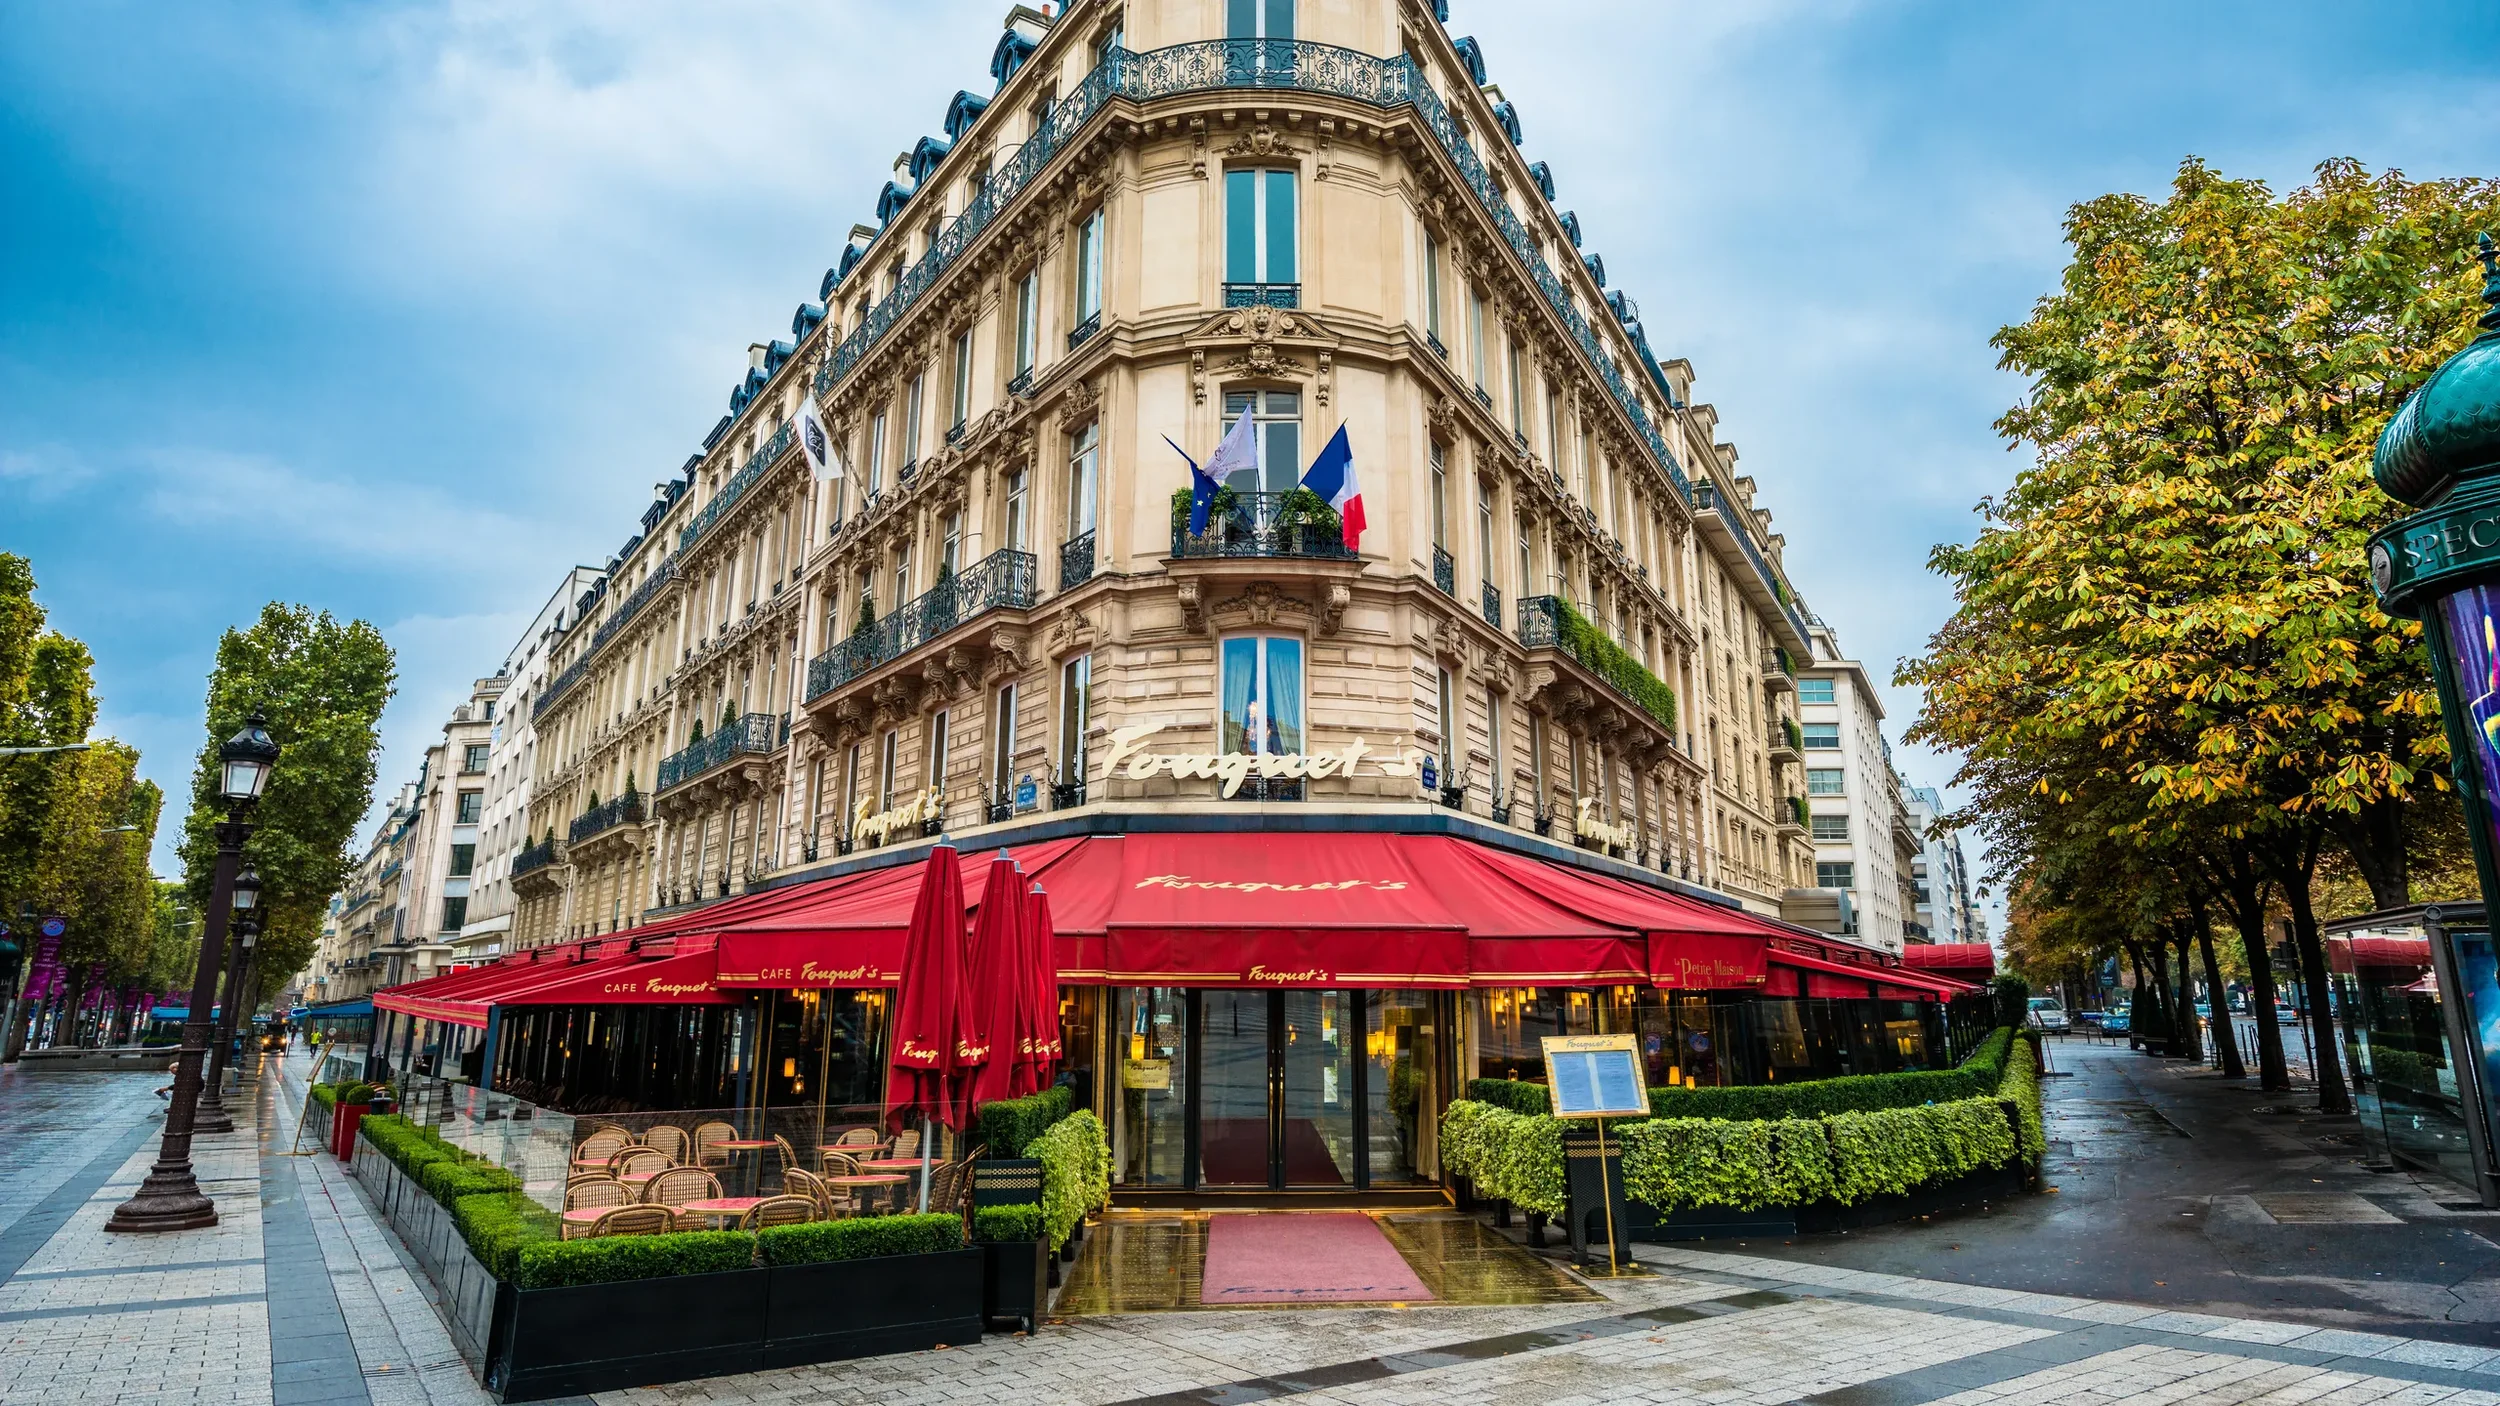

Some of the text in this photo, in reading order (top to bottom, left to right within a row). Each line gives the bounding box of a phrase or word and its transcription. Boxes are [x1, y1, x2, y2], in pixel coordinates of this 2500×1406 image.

[2403, 516, 2500, 568] SPEC
[1101, 722, 1423, 799] Fouquet's
[852, 785, 942, 847] Fouquet's
[1134, 874, 1409, 892] Fouquet's
[761, 961, 879, 986] CAFE Fouquet's
[1247, 964, 1329, 985] Fouquet's
[1680, 958, 1712, 987] Petite
[1714, 959, 1744, 976] Maison
[604, 983, 637, 993] CAFE
[1566, 1039, 1613, 1050] Fouquet's
